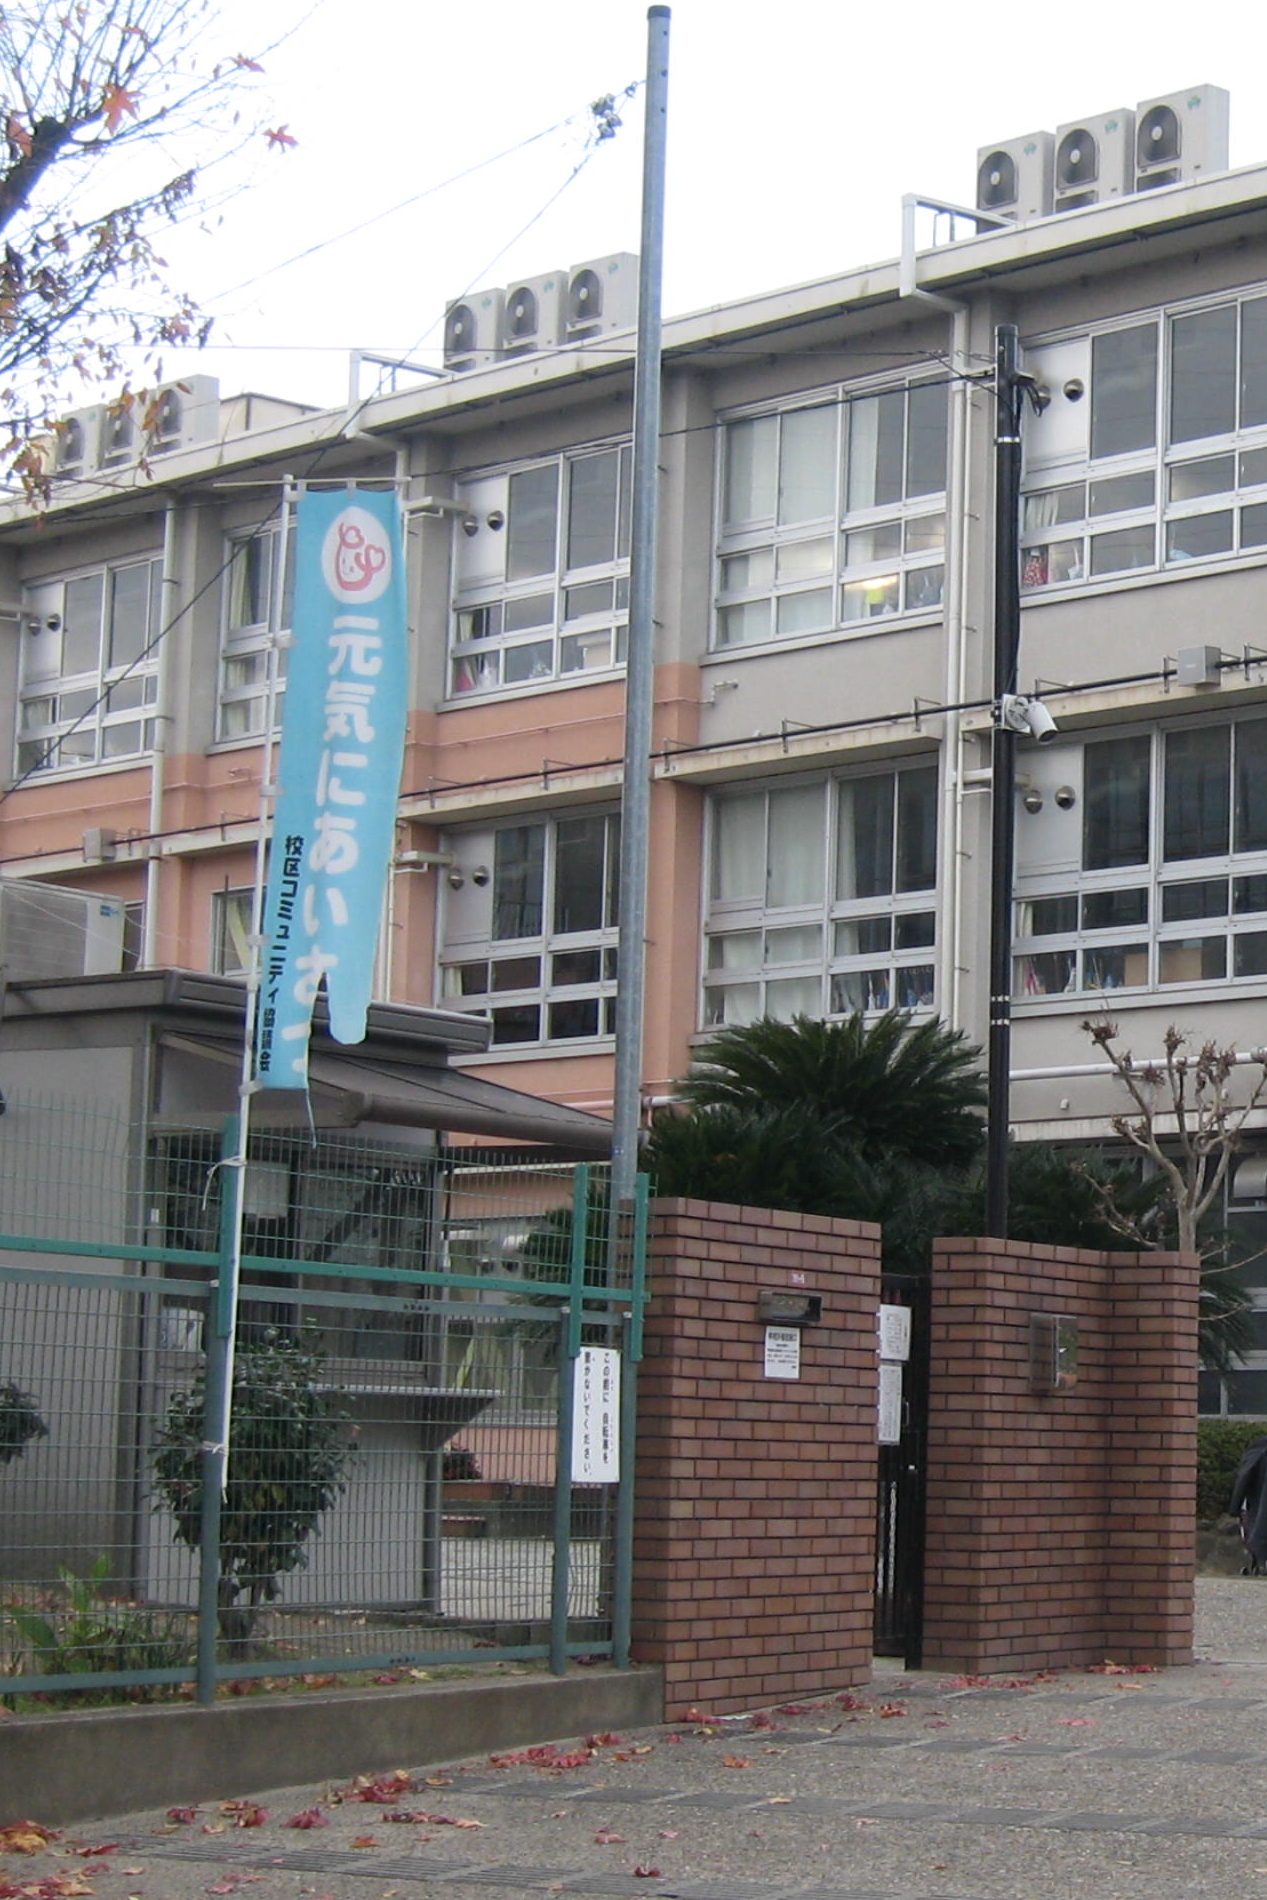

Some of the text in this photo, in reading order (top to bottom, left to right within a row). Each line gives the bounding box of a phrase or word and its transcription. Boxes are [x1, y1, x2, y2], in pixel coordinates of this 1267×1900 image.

[281, 614, 384, 1073] 元気にあいさ
